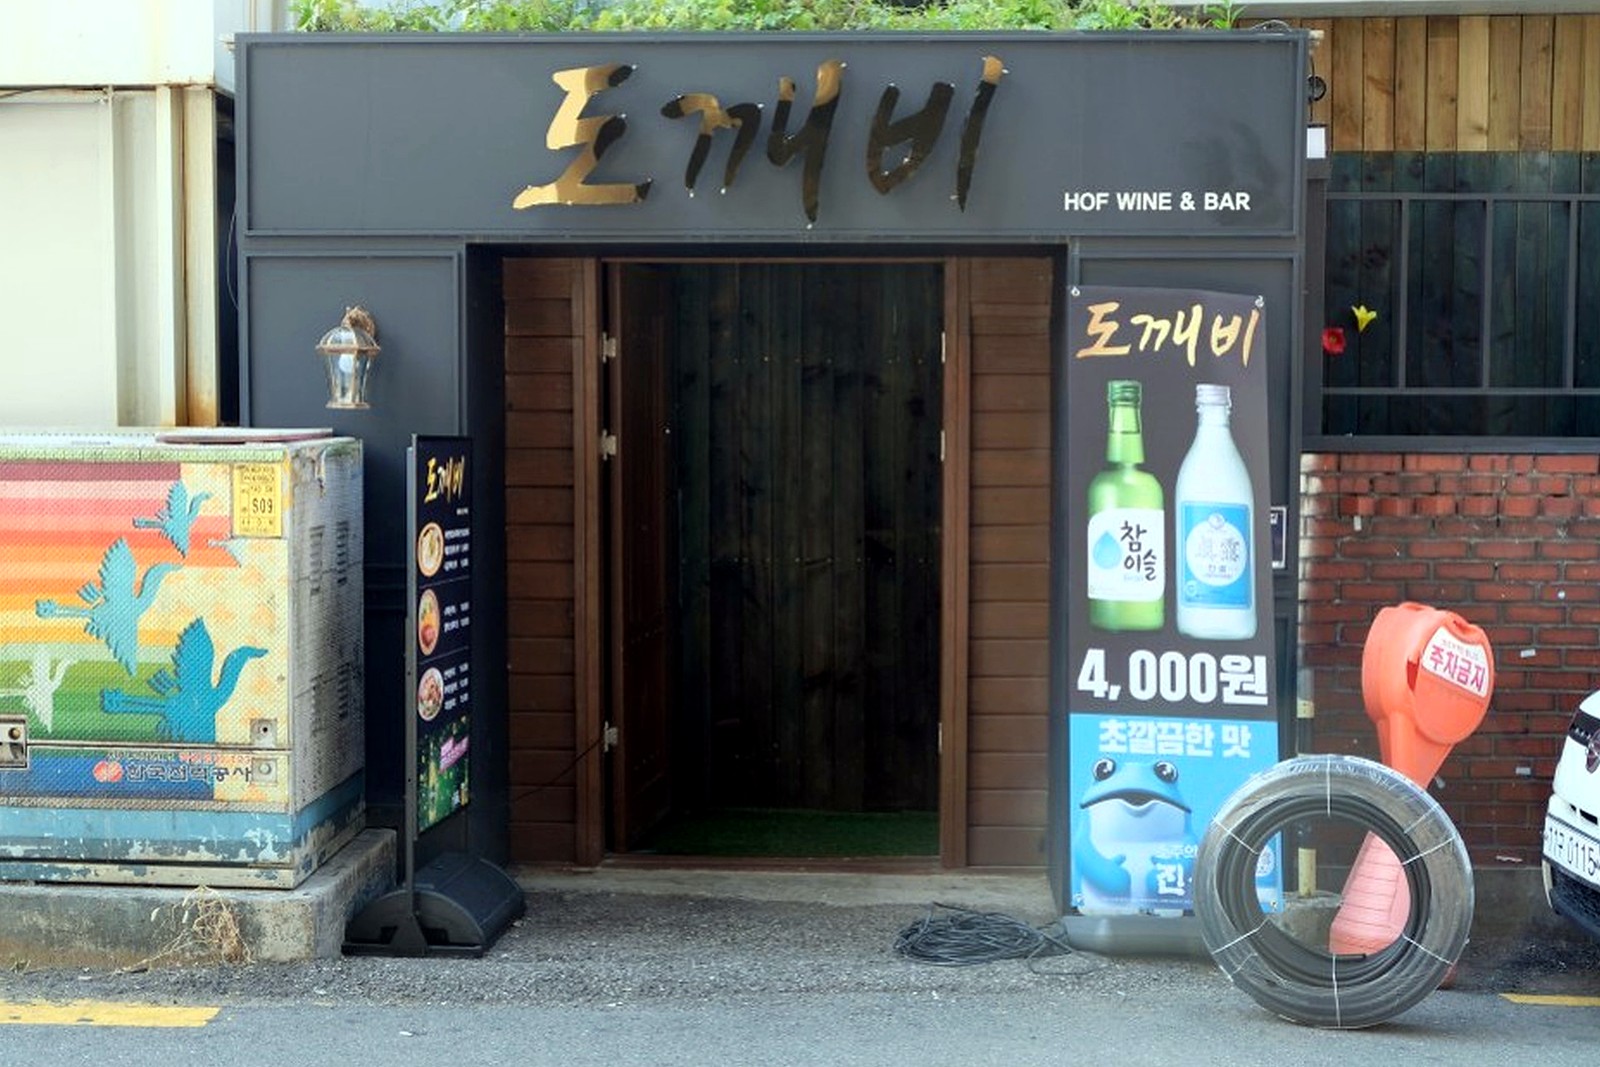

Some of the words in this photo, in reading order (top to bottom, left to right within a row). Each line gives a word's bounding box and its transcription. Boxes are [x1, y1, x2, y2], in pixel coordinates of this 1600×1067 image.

[513, 56, 1004, 224] 도깨비
[1064, 192, 1110, 211] HOF
[1116, 192, 1172, 211] WINE
[1180, 191, 1196, 211] &
[1203, 192, 1251, 211] BAR
[1076, 302, 1261, 368] 도깨비
[1120, 520, 1148, 552] 참
[1123, 549, 1158, 582] 이슬
[1077, 648, 1268, 706] 4,000원
[1429, 644, 1486, 692] 주차금지
[1098, 719, 1215, 757] 초깔끔한
[1221, 724, 1251, 758] 맛
